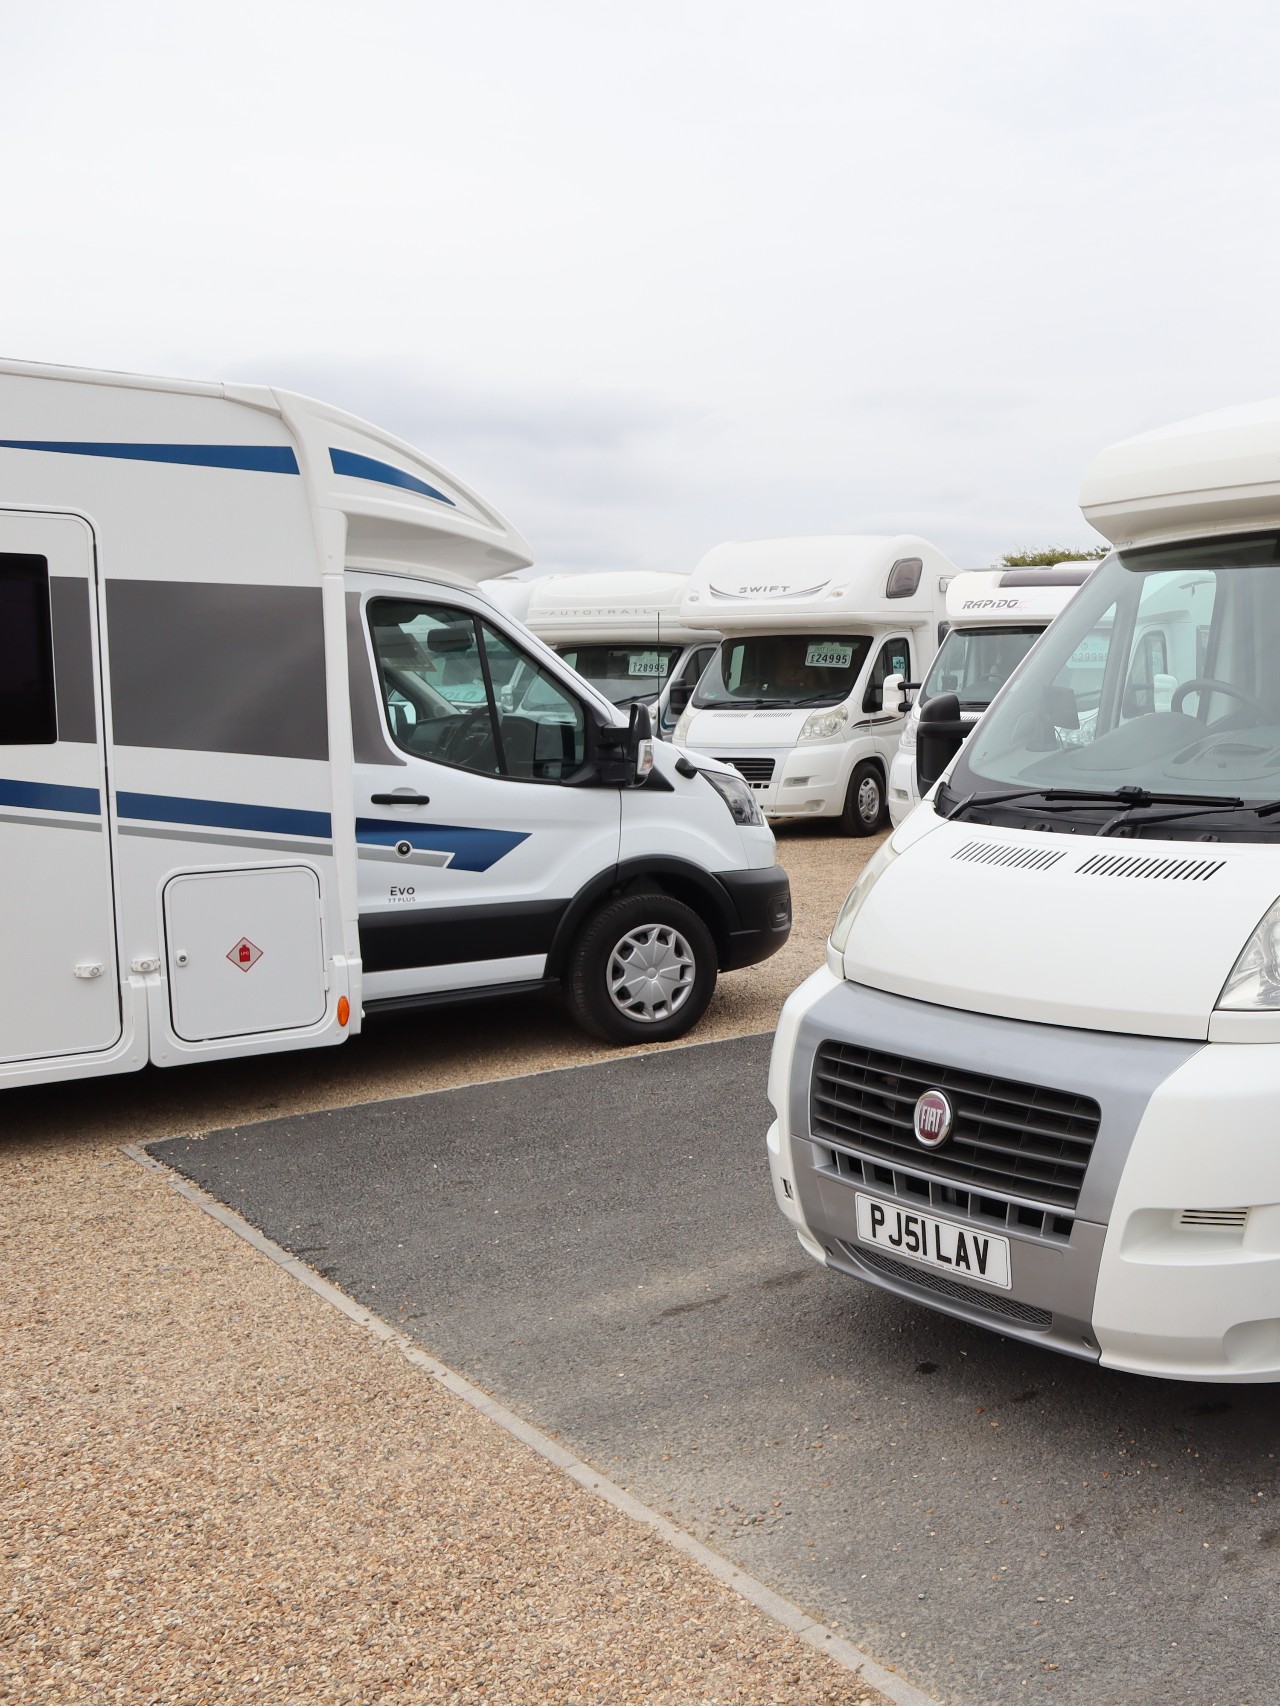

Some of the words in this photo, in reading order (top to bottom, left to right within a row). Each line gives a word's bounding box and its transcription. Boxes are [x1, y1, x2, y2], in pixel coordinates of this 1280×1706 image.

[738, 585, 790, 594] SWIFT
[810, 653, 848, 664] £24995
[390, 886, 415, 896] EVO
[920, 1105, 943, 1133] FIAT
[870, 1203, 928, 1257] PJ51
[935, 1223, 989, 1275] LAV
